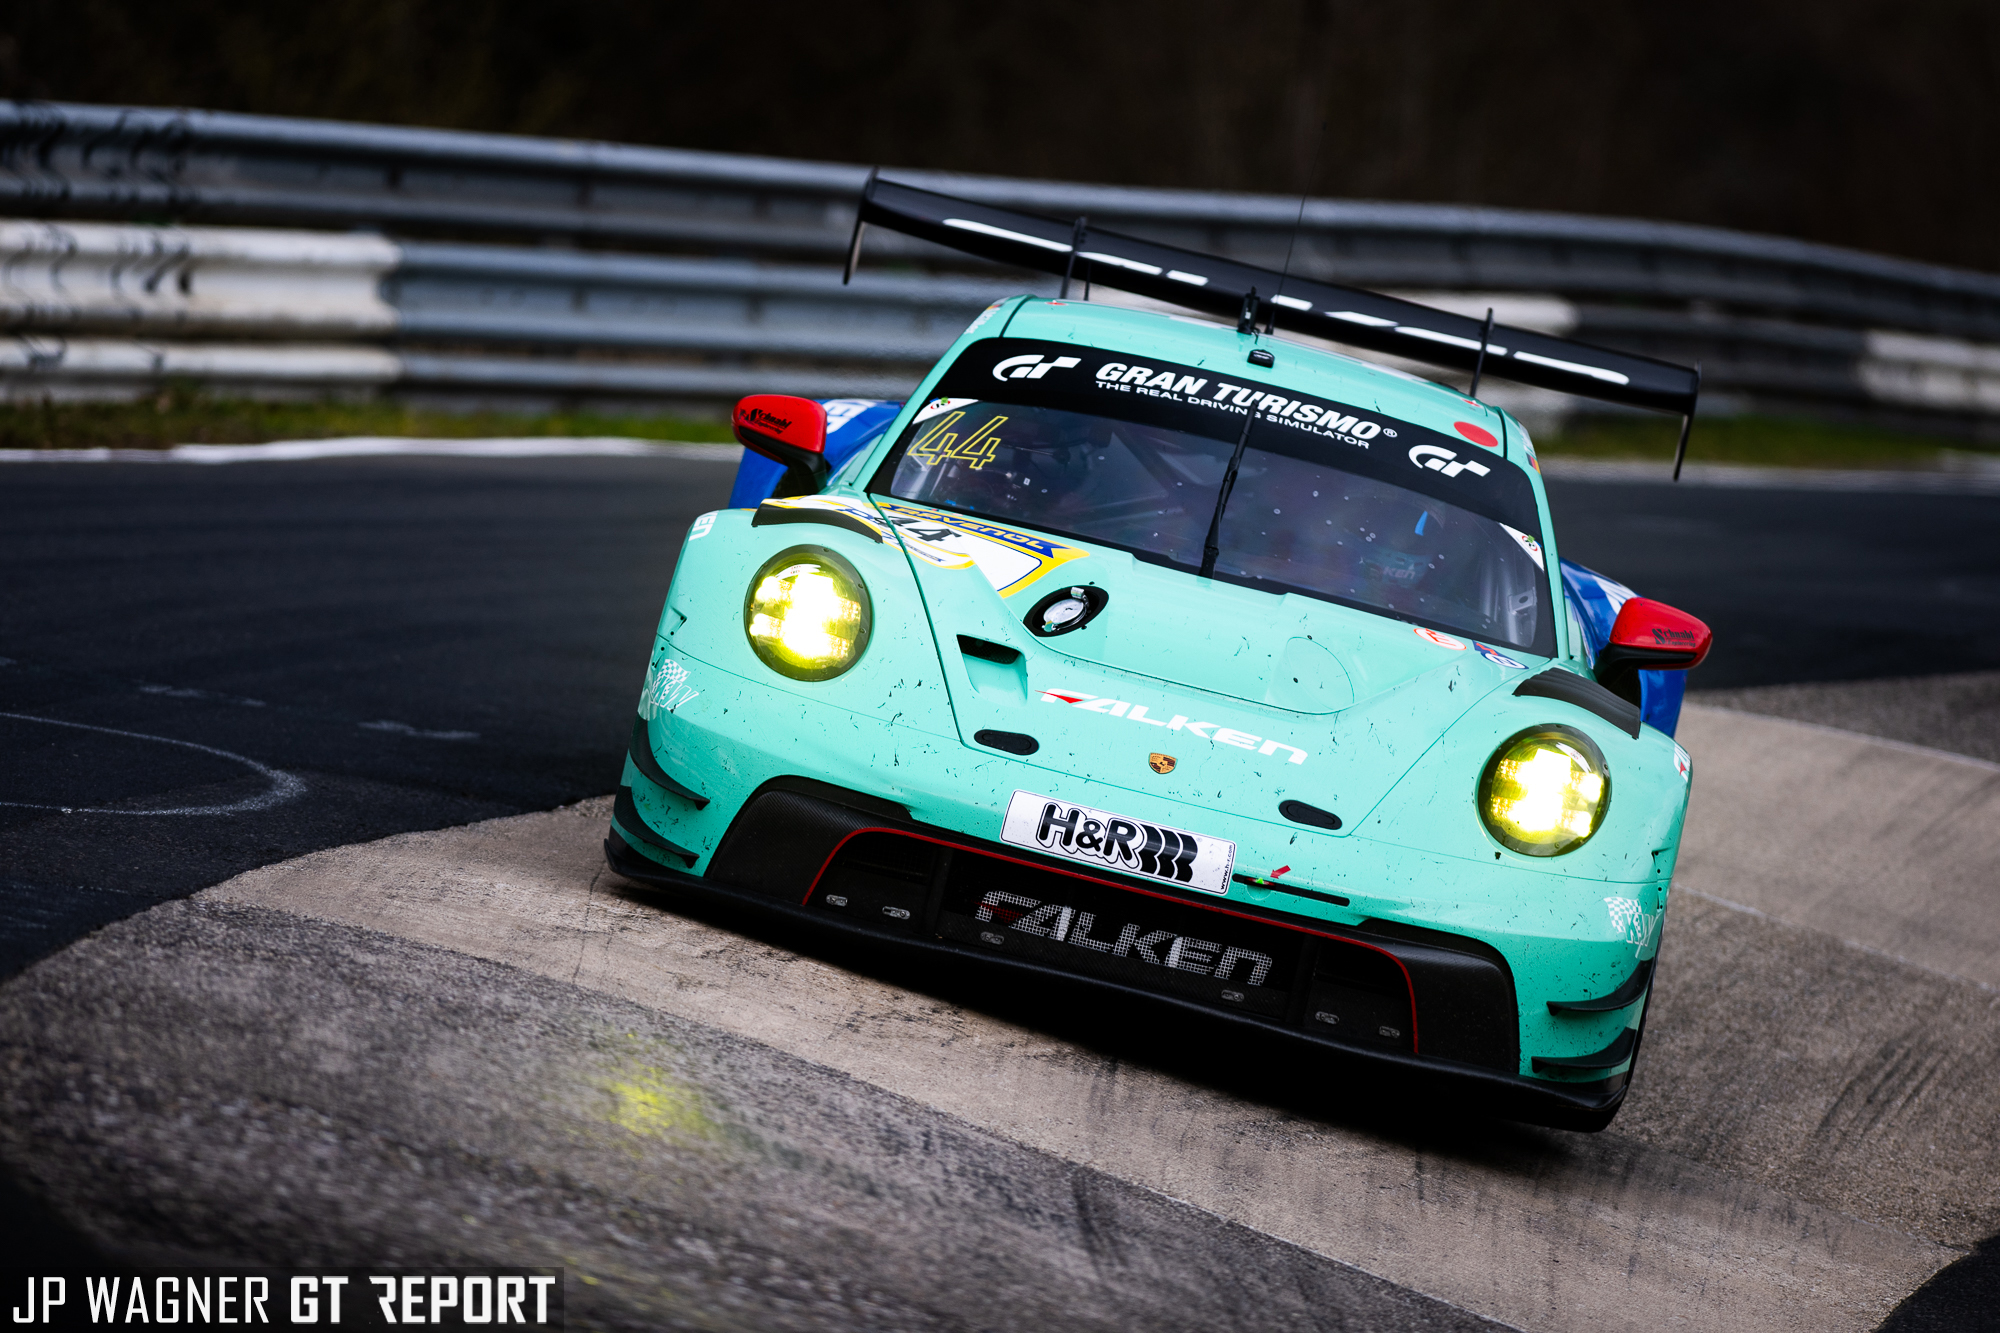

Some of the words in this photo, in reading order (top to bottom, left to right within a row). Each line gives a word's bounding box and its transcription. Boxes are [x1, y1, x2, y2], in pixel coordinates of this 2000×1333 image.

[1095, 362, 1208, 395] GRAN
[907, 411, 1009, 469] 44
[1095, 380, 1131, 393] THE
[1136, 386, 1183, 402] REAL
[1266, 414, 1370, 449] SIMULATOR
[894, 507, 1045, 551] RAVENOL
[1652, 628, 1695, 644] Schnabl
[1036, 689, 1309, 766] FALKEN
[1036, 802, 1144, 872] H&R
[1221, 844, 1233, 890] www.h-r.com
[974, 890, 1273, 987] FALKEN
